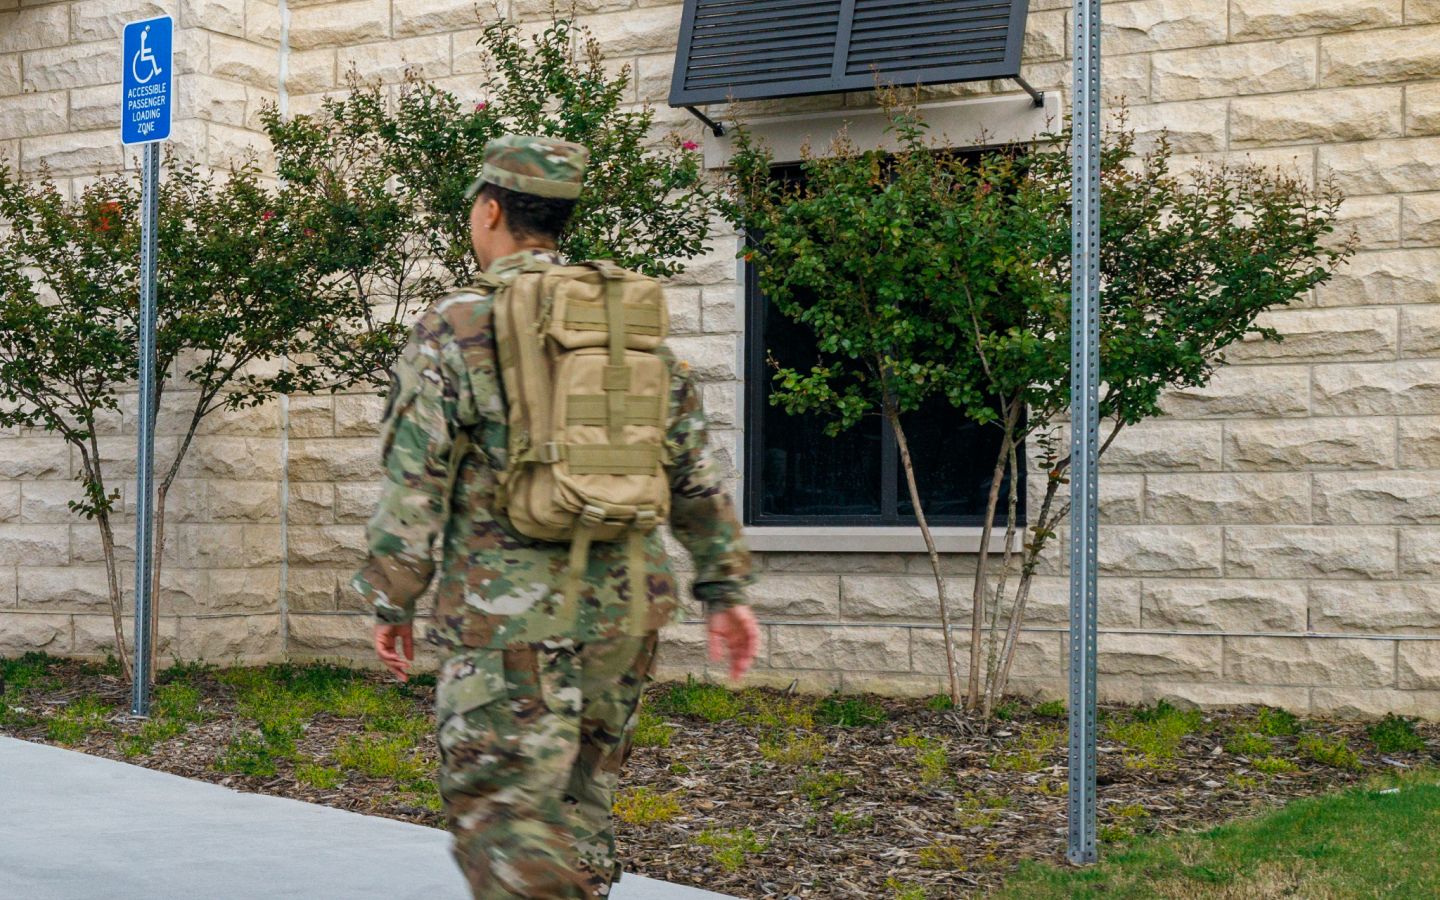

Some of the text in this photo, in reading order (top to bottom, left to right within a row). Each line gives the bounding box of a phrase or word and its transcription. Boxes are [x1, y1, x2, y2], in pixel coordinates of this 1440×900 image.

[128, 83, 166, 98] ACCESSIBLE
[128, 96, 165, 110] PASSENGER
[132, 108, 160, 122] LOADING
[137, 122, 155, 134] ZONE
